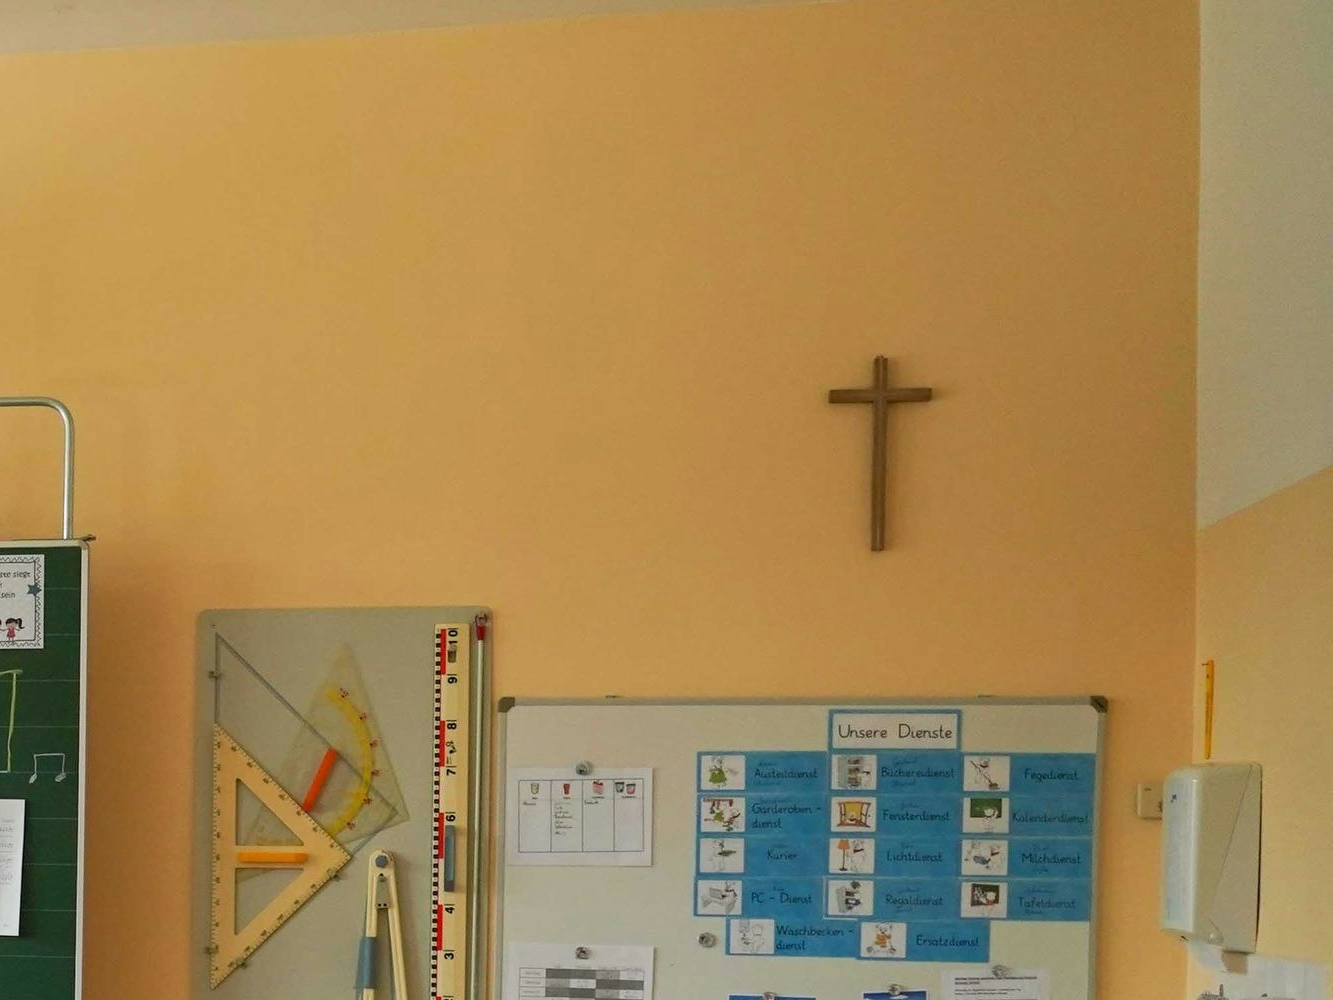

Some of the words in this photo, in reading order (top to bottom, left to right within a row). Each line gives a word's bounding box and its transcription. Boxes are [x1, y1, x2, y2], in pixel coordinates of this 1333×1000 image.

[13, 571, 31, 579] siegt
[448, 676, 458, 684] 9
[447, 722, 457, 730] 8
[838, 724, 888, 739] Unsere
[898, 723, 953, 739] Dienste
[446, 768, 456, 776] 7
[754, 768, 818, 779] Austeildienst
[881, 766, 954, 778] Büchereidienst
[1024, 768, 1078, 782] Fegedienst
[446, 814, 456, 822] 6
[882, 809, 950, 821] Fensterdienst
[1012, 812, 1089, 823] Kalenderdienst
[751, 818, 782, 829] dienst
[767, 850, 798, 861] Kurier
[886, 851, 943, 863] Lichtdienst
[1021, 853, 1082, 865] Milchdienst
[779, 891, 813, 904] Dienst
[885, 893, 944, 907] Regaldienst
[1018, 896, 1076, 909] Tafeldienst
[445, 906, 455, 914] 4
[775, 925, 845, 937] Waschbecken
[775, 940, 806, 950] dienst
[916, 934, 980, 946] Ersatzdienst
[444, 952, 454, 960] 3
